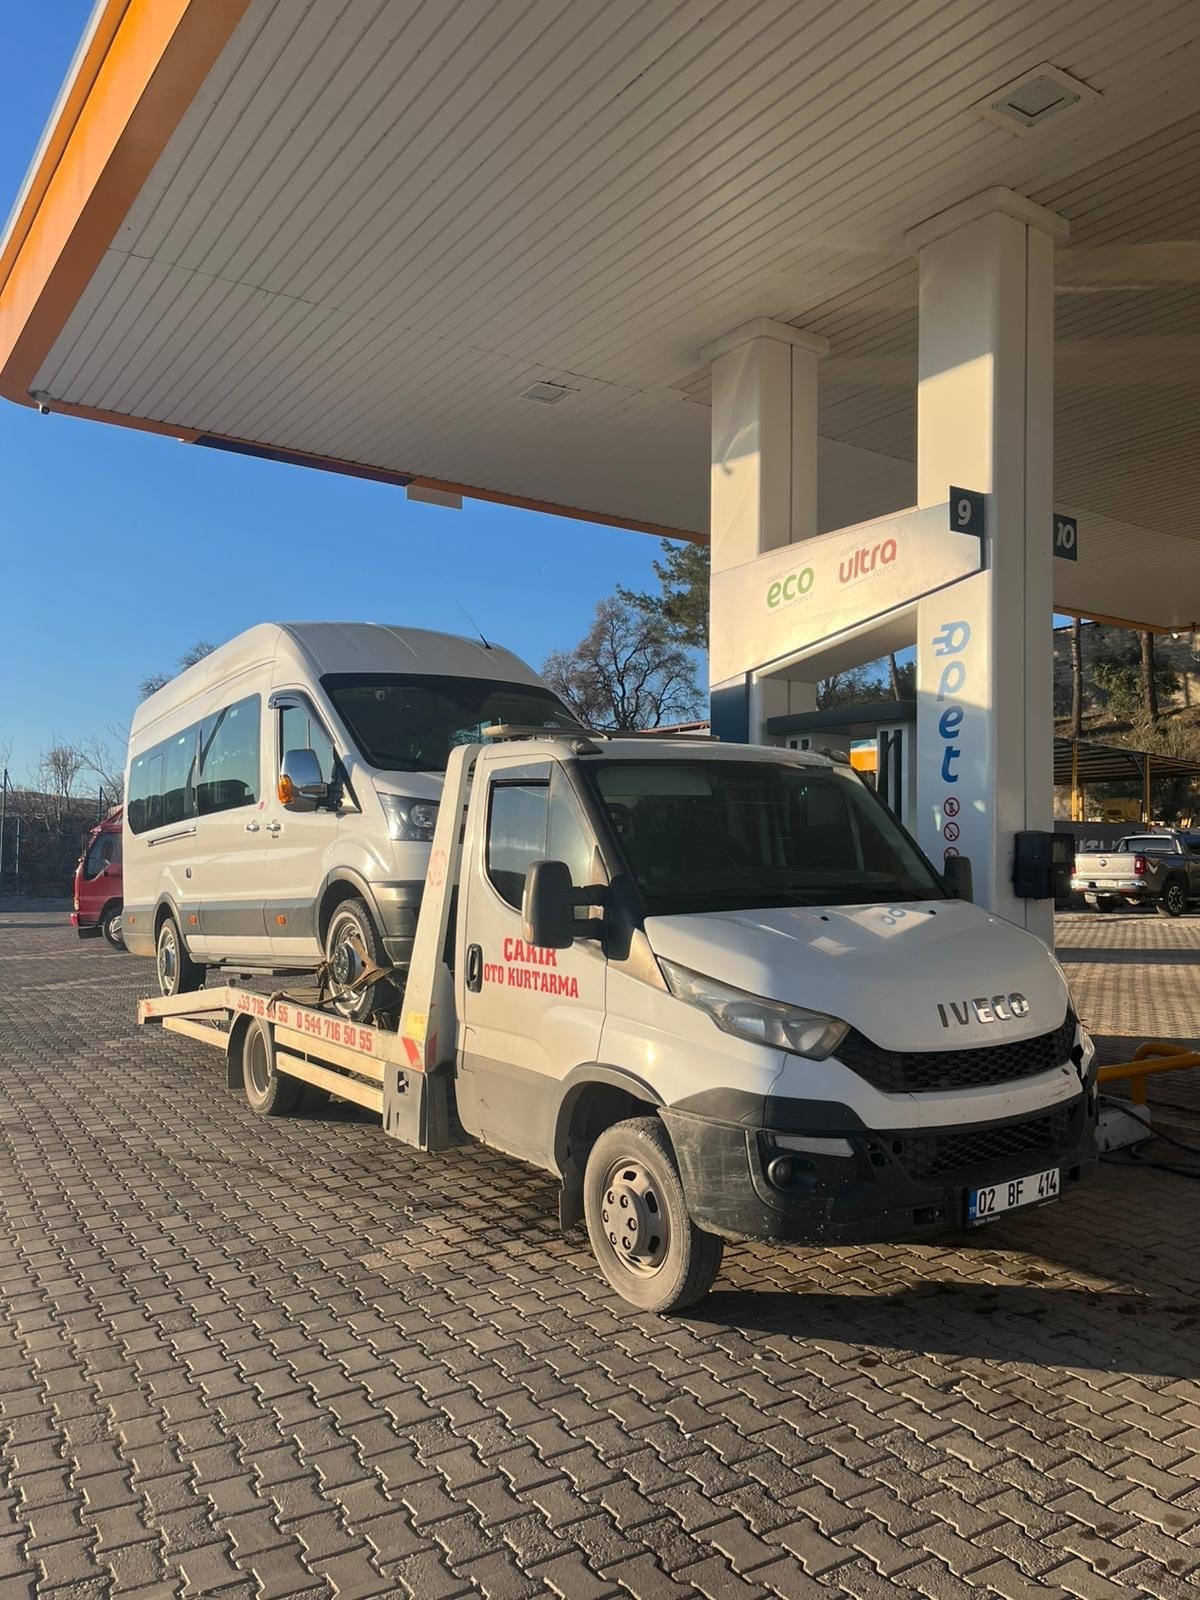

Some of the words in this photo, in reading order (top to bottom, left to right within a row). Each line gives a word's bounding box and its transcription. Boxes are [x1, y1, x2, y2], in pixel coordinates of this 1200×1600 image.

[957, 498, 972, 526] 9
[1056, 521, 1075, 549] 10
[839, 538, 897, 584] ultra
[767, 567, 815, 608] eco
[484, 963, 504, 984] OTO
[507, 966, 579, 998] KURTARMA
[252, 997, 265, 1016] 716
[278, 1003, 289, 1023] 55
[937, 992, 1030, 1028] IVECO
[296, 1010, 303, 1029] 0
[304, 1013, 322, 1035] 544
[324, 1019, 341, 1041] 716
[343, 1024, 356, 1047] 50
[359, 1029, 373, 1052] 55
[978, 1188, 996, 1214] 02
[1008, 1180, 1025, 1206] BF
[1037, 1170, 1057, 1197] 414
